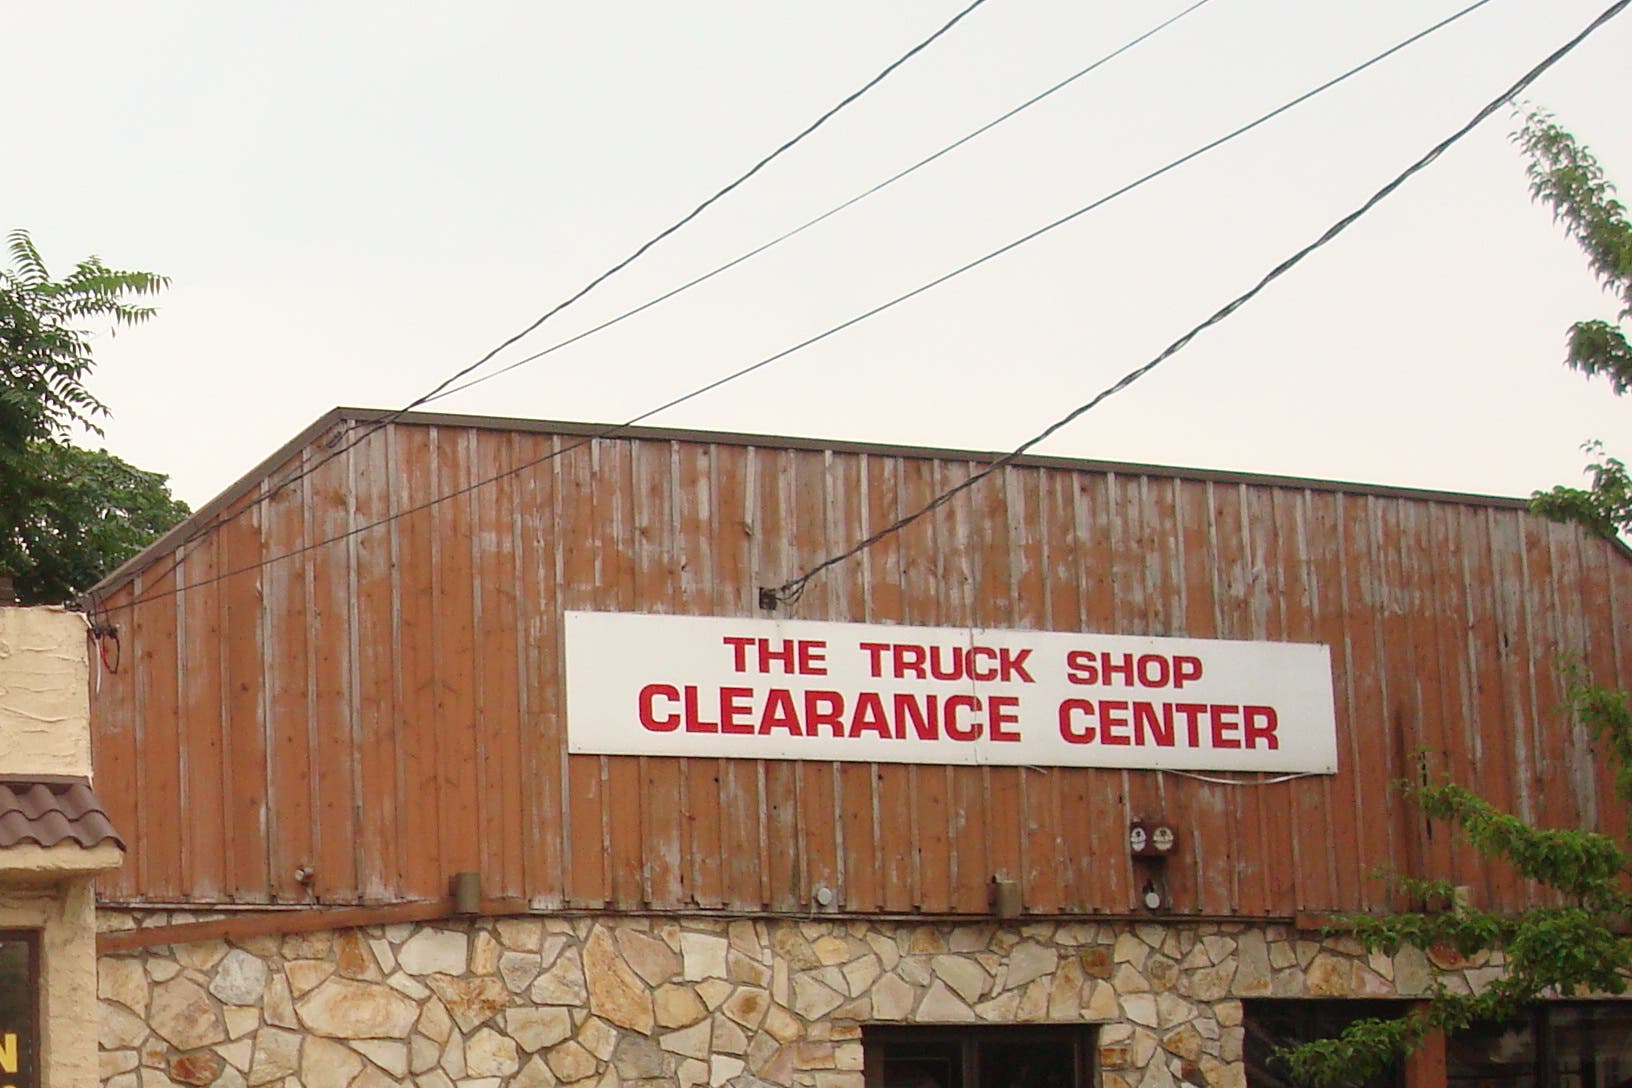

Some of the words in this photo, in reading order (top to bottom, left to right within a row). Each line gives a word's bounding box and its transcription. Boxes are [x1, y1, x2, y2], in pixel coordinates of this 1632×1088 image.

[723, 636, 828, 677] THE
[859, 642, 1035, 684] TRUCK
[1066, 650, 1203, 689] SHOP
[638, 683, 1021, 743] CLEARANCE
[1059, 698, 1279, 751] CENTER
